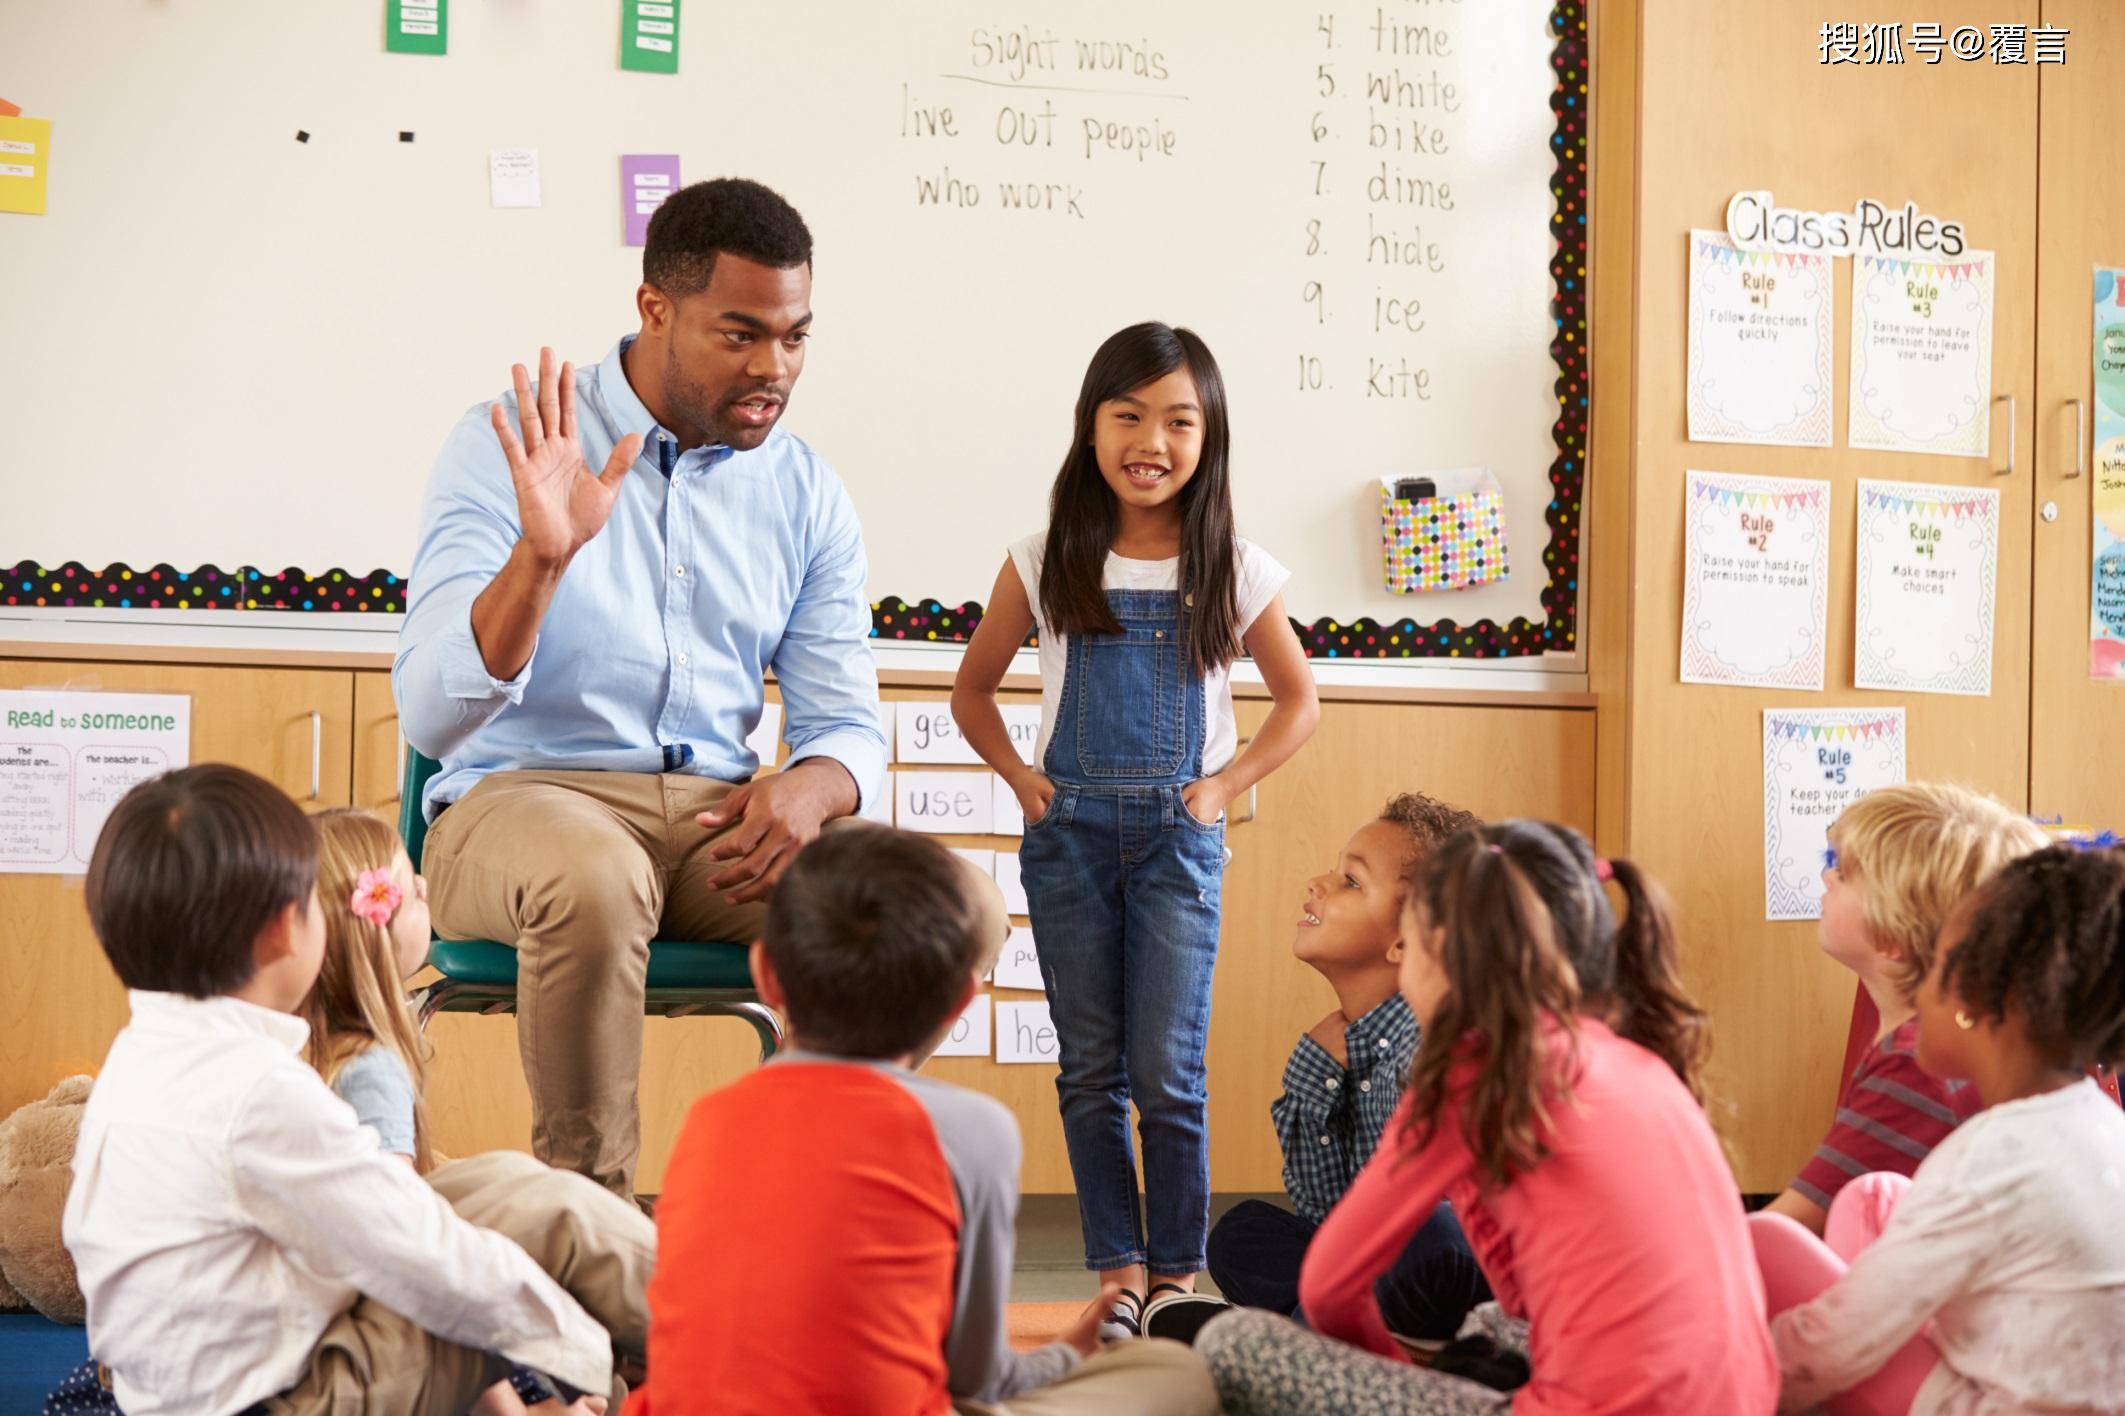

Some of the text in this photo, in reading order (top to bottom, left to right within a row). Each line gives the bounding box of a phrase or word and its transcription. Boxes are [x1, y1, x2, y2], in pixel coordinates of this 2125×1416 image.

[1369, 8, 1453, 57] time
[1075, 38, 1168, 80] words
[1367, 67, 1462, 113] white
[901, 82, 959, 136] live
[1083, 117, 1176, 162] people
[1369, 105, 1449, 155] bike
[916, 166, 1084, 219] who work
[1368, 161, 1455, 211] dime
[1734, 196, 1964, 256] Class Rules
[1367, 212, 1445, 273] hide
[1742, 271, 1776, 291] Rule
[1906, 280, 1939, 301] Rule
[1375, 285, 1425, 333] ice
[1750, 292, 1768, 309] #1
[1913, 301, 1932, 319] #3
[1710, 309, 1808, 327] Follow directions
[1738, 328, 1779, 342] quickly
[1873, 320, 1971, 339] Raise your hand for
[1873, 335, 1970, 352] permission to leave
[1897, 350, 1945, 362] your seat
[1299, 354, 1432, 401] 10. kite
[1740, 512, 1775, 533] Rule
[1909, 522, 1942, 542] Rule
[1748, 534, 1768, 552] #2
[1916, 543, 1934, 560] #4
[1703, 553, 1809, 573] Raise your hand for
[1892, 565, 1957, 580] Make smart
[1703, 569, 1809, 587] permission to speak
[1903, 581, 1945, 595] choices
[8, 709, 176, 731] Read to someone
[17, 747, 32, 756] The
[86, 755, 101, 763] The
[1818, 747, 1852, 766] Rule
[1825, 768, 1846, 784] #5
[911, 790, 974, 818] use
[1790, 787, 1821, 801] Keep
[1824, 789, 1850, 802] your
[1790, 802, 1836, 816] teacher
